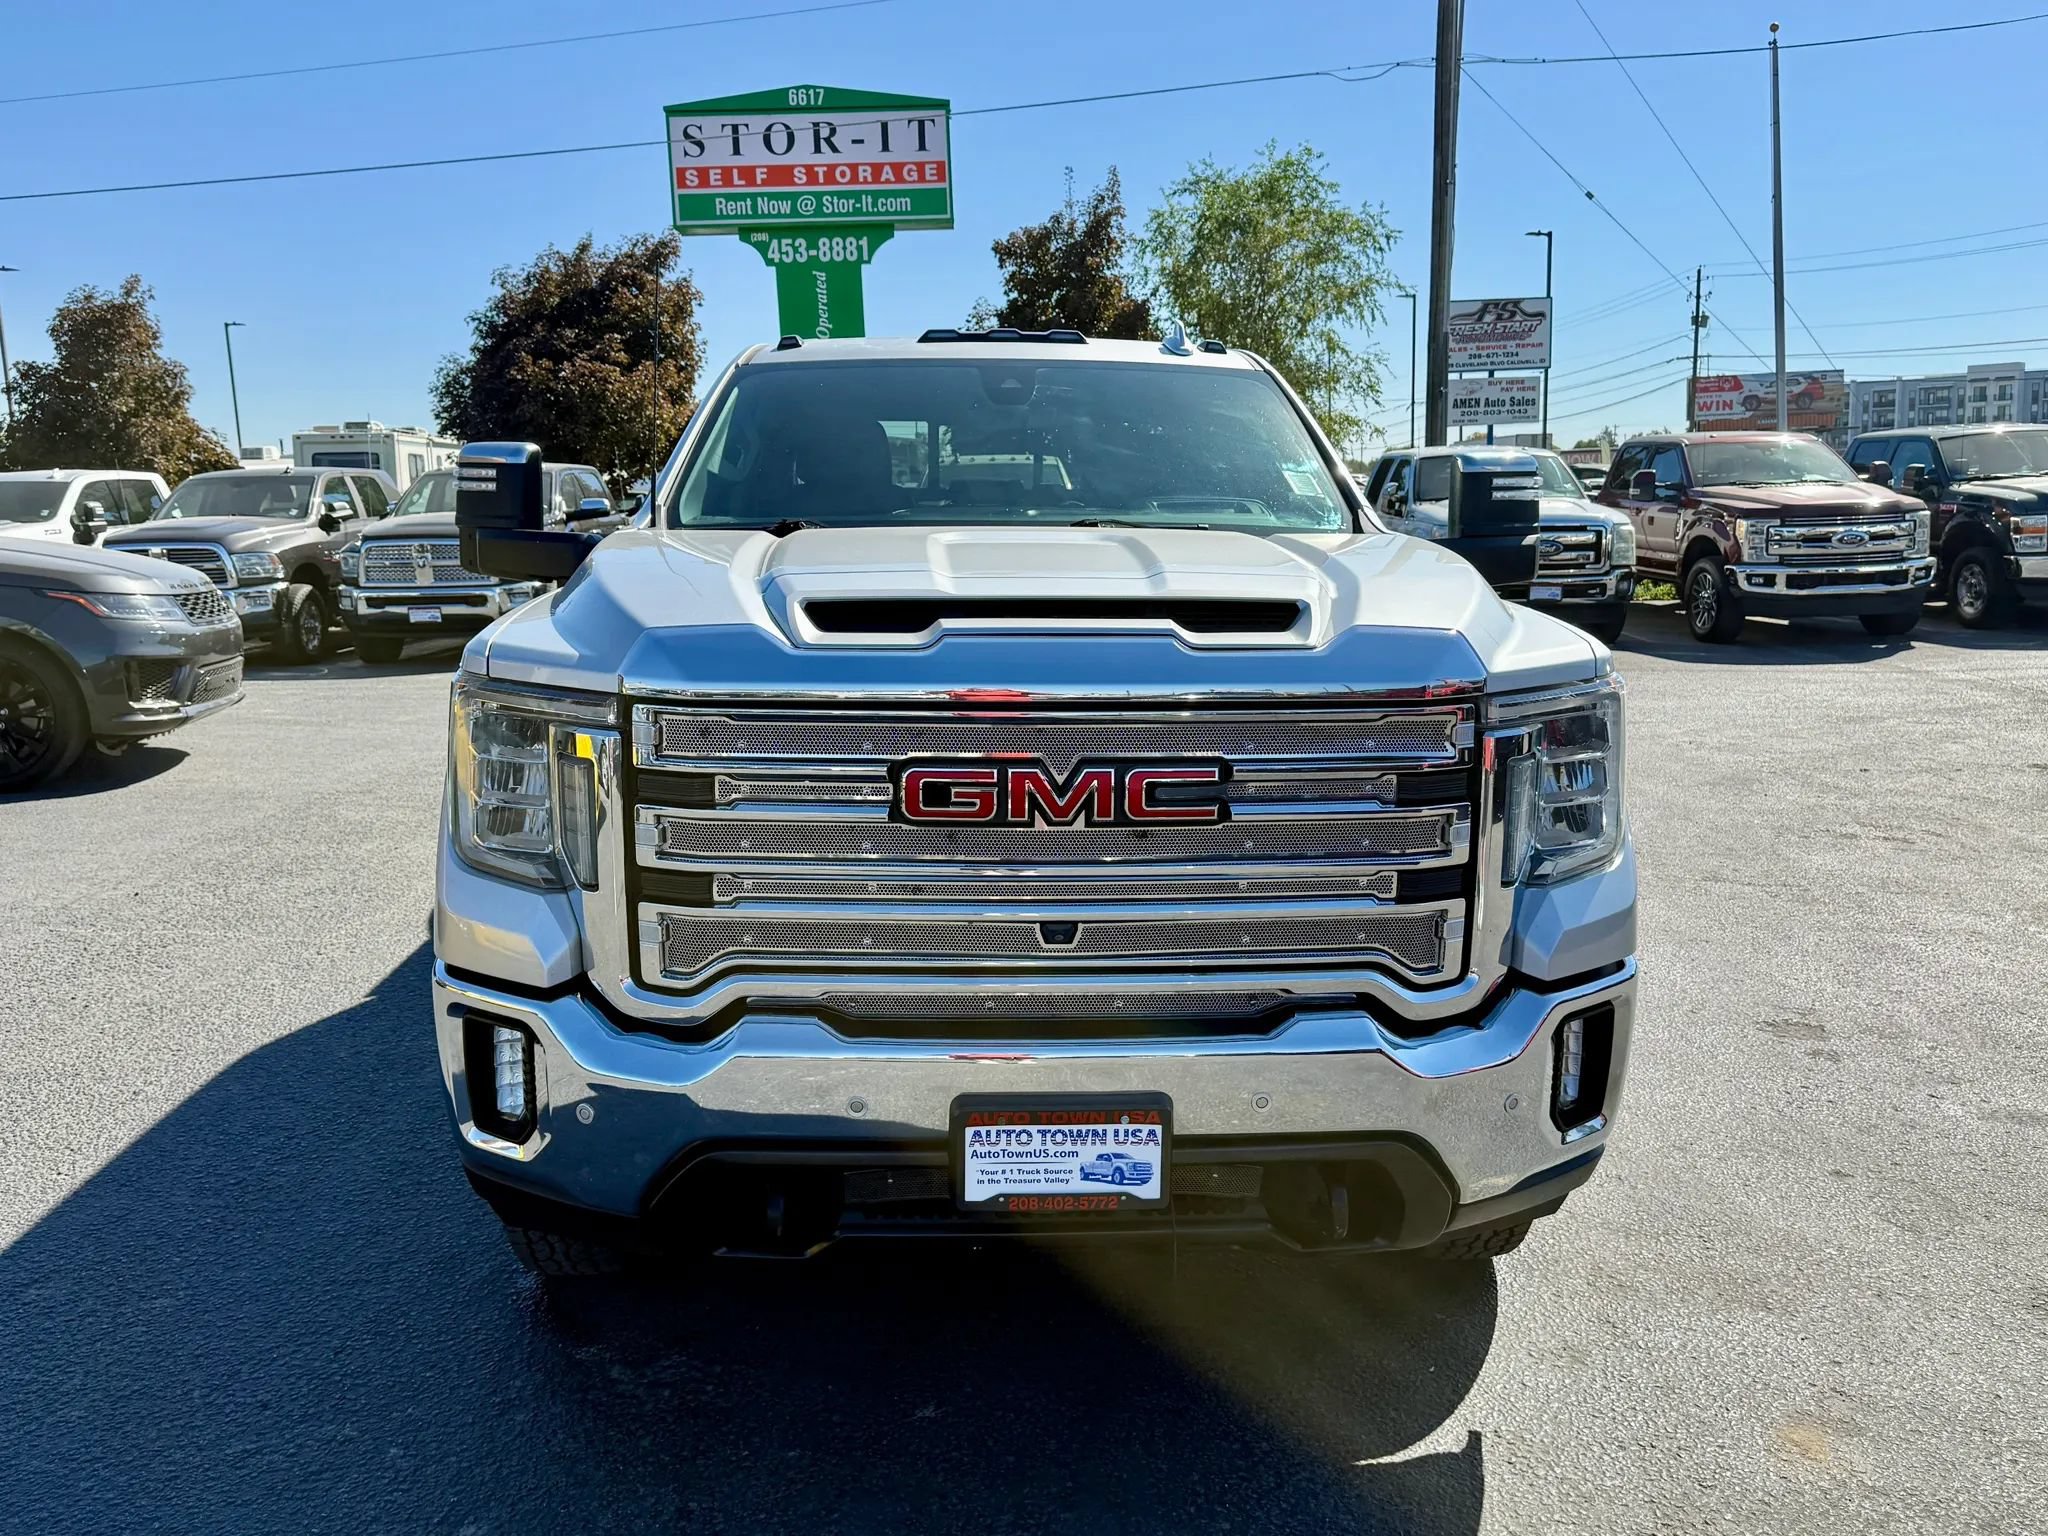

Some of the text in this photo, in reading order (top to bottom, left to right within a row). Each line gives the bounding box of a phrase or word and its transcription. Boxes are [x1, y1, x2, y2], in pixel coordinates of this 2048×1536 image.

[788, 88, 825, 106] 6617
[682, 118, 936, 158] STOR-IT
[685, 163, 938, 187] SELF STORAGE
[715, 195, 912, 216] Rent Now @ Stor-It.com
[767, 236, 871, 263] 453-8881
[813, 270, 831, 340] Operated
[1494, 320, 1543, 334] START
[1452, 396, 1537, 409] AMEN Auto Sales
[1696, 399, 1733, 412] WIN
[900, 768, 1219, 821] GMC
[967, 1110, 1161, 1126] AUTO TOWN USA
[968, 1128, 1161, 1148] AUTO TOWN USA
[970, 1148, 1079, 1160] AutoTownUS.com
[1004, 1177, 1042, 1185] Treasure
